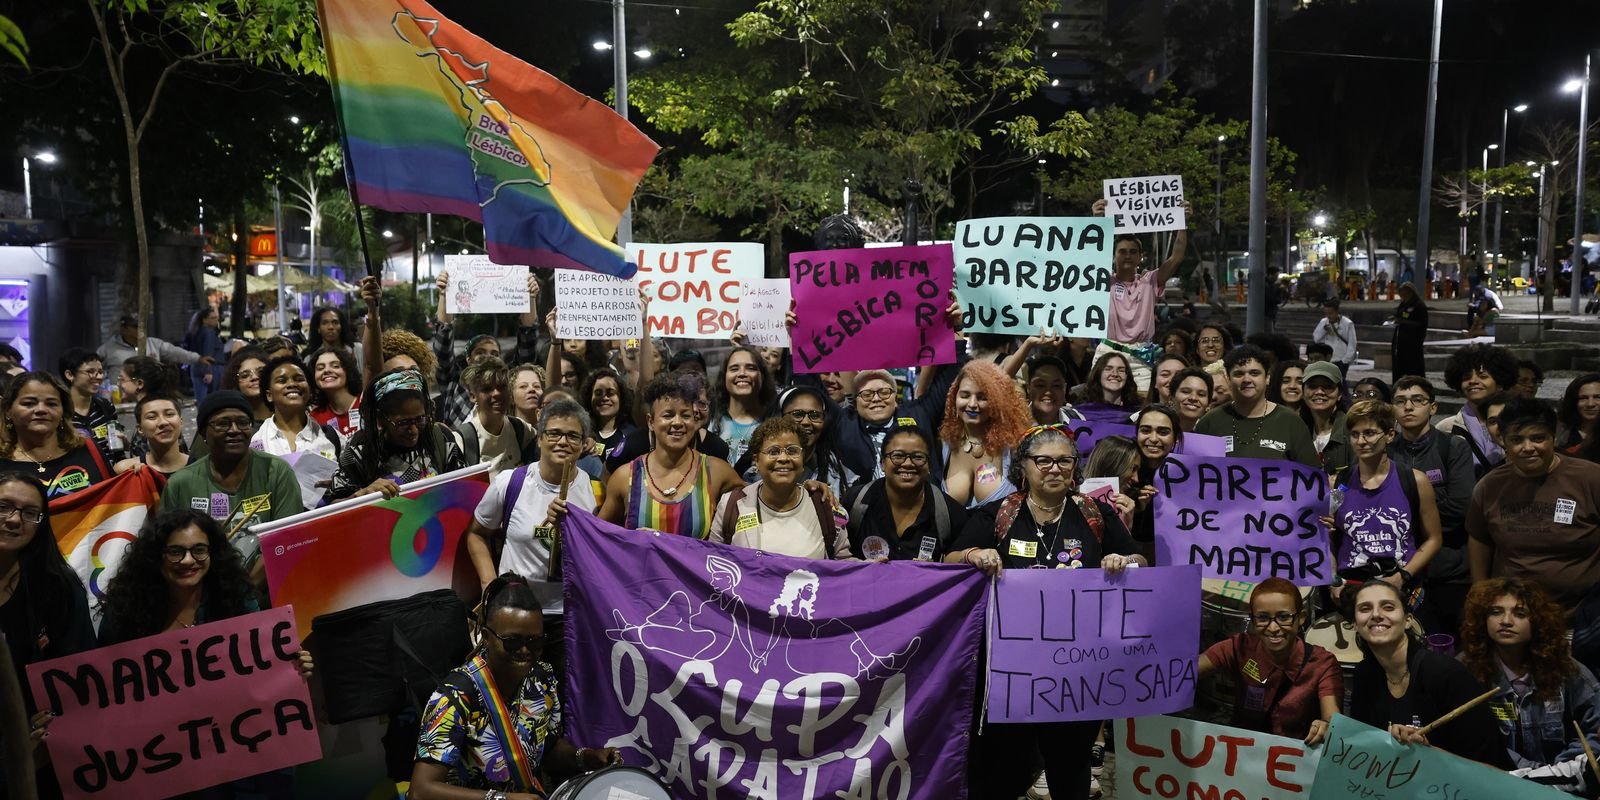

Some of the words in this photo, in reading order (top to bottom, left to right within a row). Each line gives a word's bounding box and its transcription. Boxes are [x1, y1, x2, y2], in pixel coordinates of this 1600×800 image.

[472, 134, 528, 166] Lésbicas
[1109, 179, 1179, 197] LÉSBICAS
[1114, 214, 1125, 227] E
[1131, 212, 1175, 227] VIVAS
[962, 223, 1105, 252] LUANA
[638, 249, 732, 273] LUTE
[793, 259, 860, 288] PELA
[964, 258, 1111, 292] BARBOSA
[558, 273, 577, 282] PELA
[558, 287, 569, 296] DO
[570, 287, 610, 296] PROJETO
[612, 287, 624, 296] DE
[625, 287, 636, 297] LEI
[559, 300, 588, 310] LUANA
[590, 300, 637, 311] BARBOSA
[559, 313, 569, 322] DE
[568, 313, 637, 323] ENFRENTAMENTO
[559, 325, 571, 335] AO
[574, 325, 637, 337] LESBOCÍDIO!
[798, 290, 902, 370] LÉSBICA
[1158, 456, 1326, 501] PAREM
[1176, 508, 1221, 531] DE
[1243, 509, 1318, 540] NOS
[1189, 543, 1326, 581] MATAR
[994, 580, 1153, 642] LUTE
[1052, 646, 1110, 666] COMO
[1123, 642, 1158, 656] UMA
[41, 621, 299, 717] MARIELLE
[611, 641, 910, 760] OCUPA
[1126, 717, 1305, 793] LUTE
